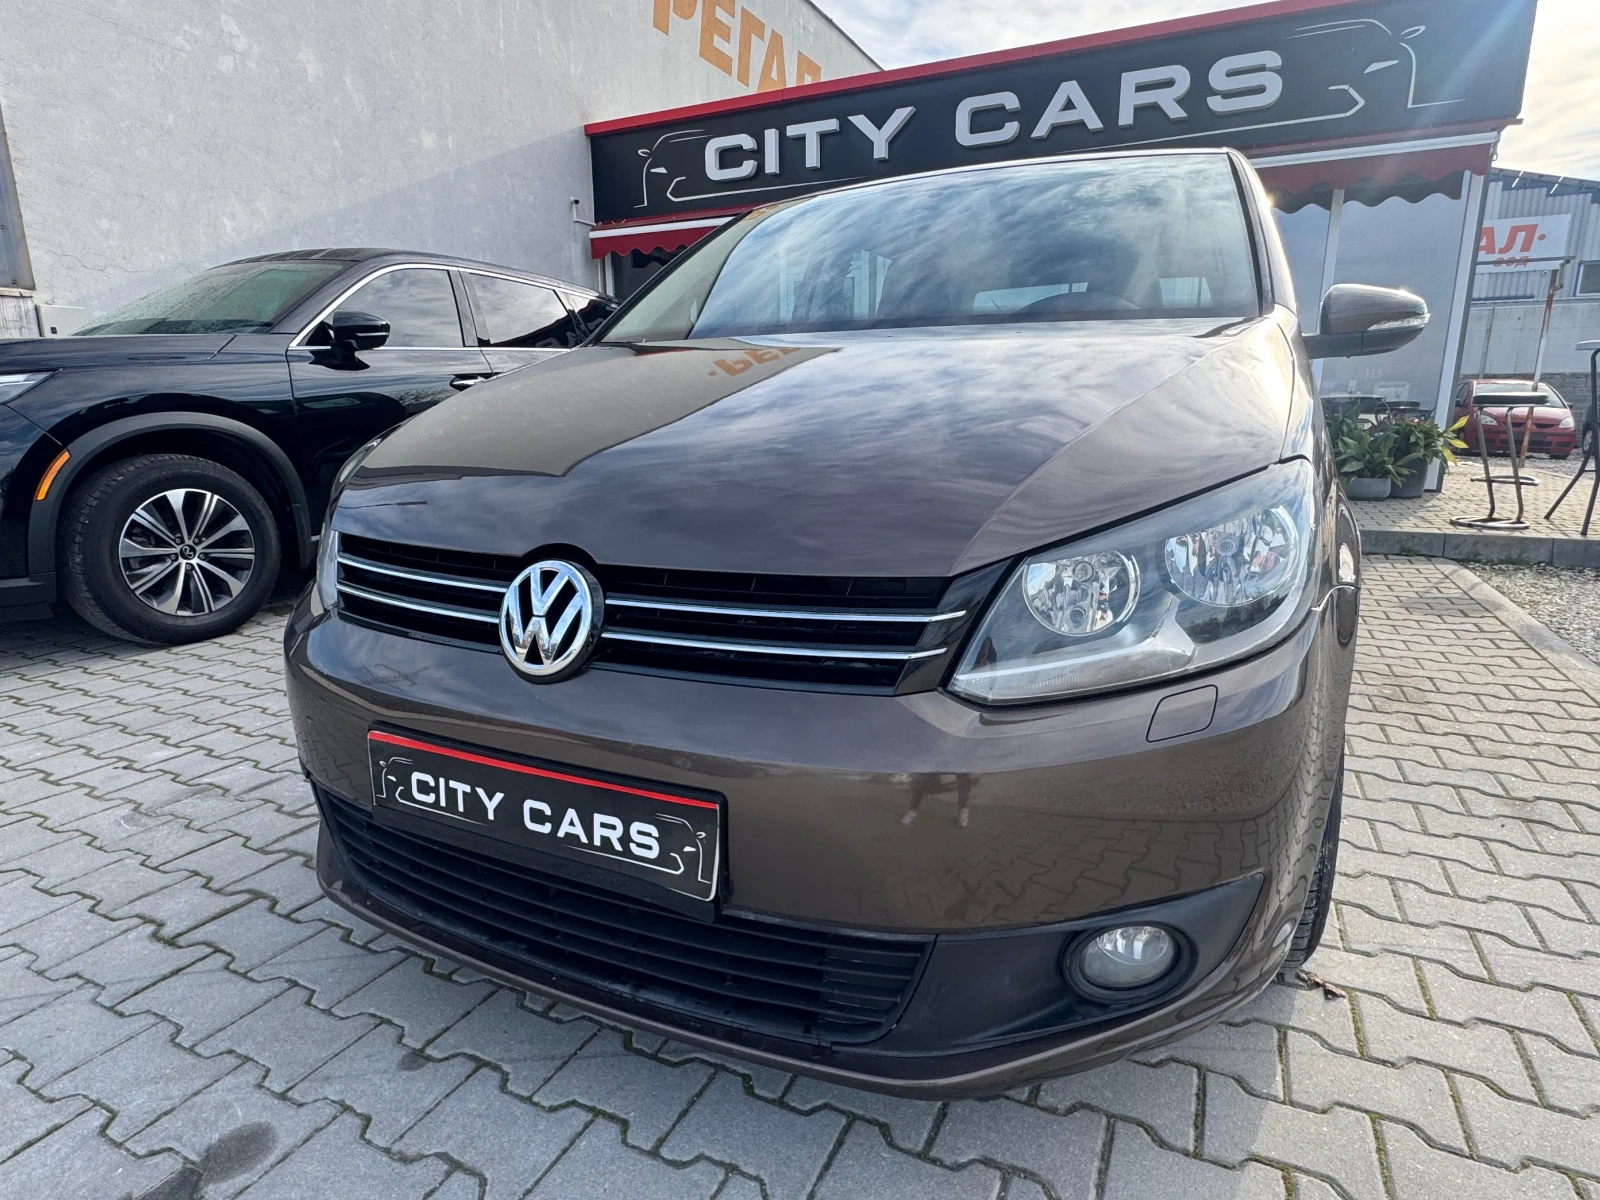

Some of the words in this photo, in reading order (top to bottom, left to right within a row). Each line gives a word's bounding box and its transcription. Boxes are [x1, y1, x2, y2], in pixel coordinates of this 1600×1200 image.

[704, 106, 916, 181] CITY
[955, 50, 1283, 147] CARS
[500, 560, 593, 676] VW
[411, 771, 505, 820] CITY
[523, 799, 660, 859] CARS
